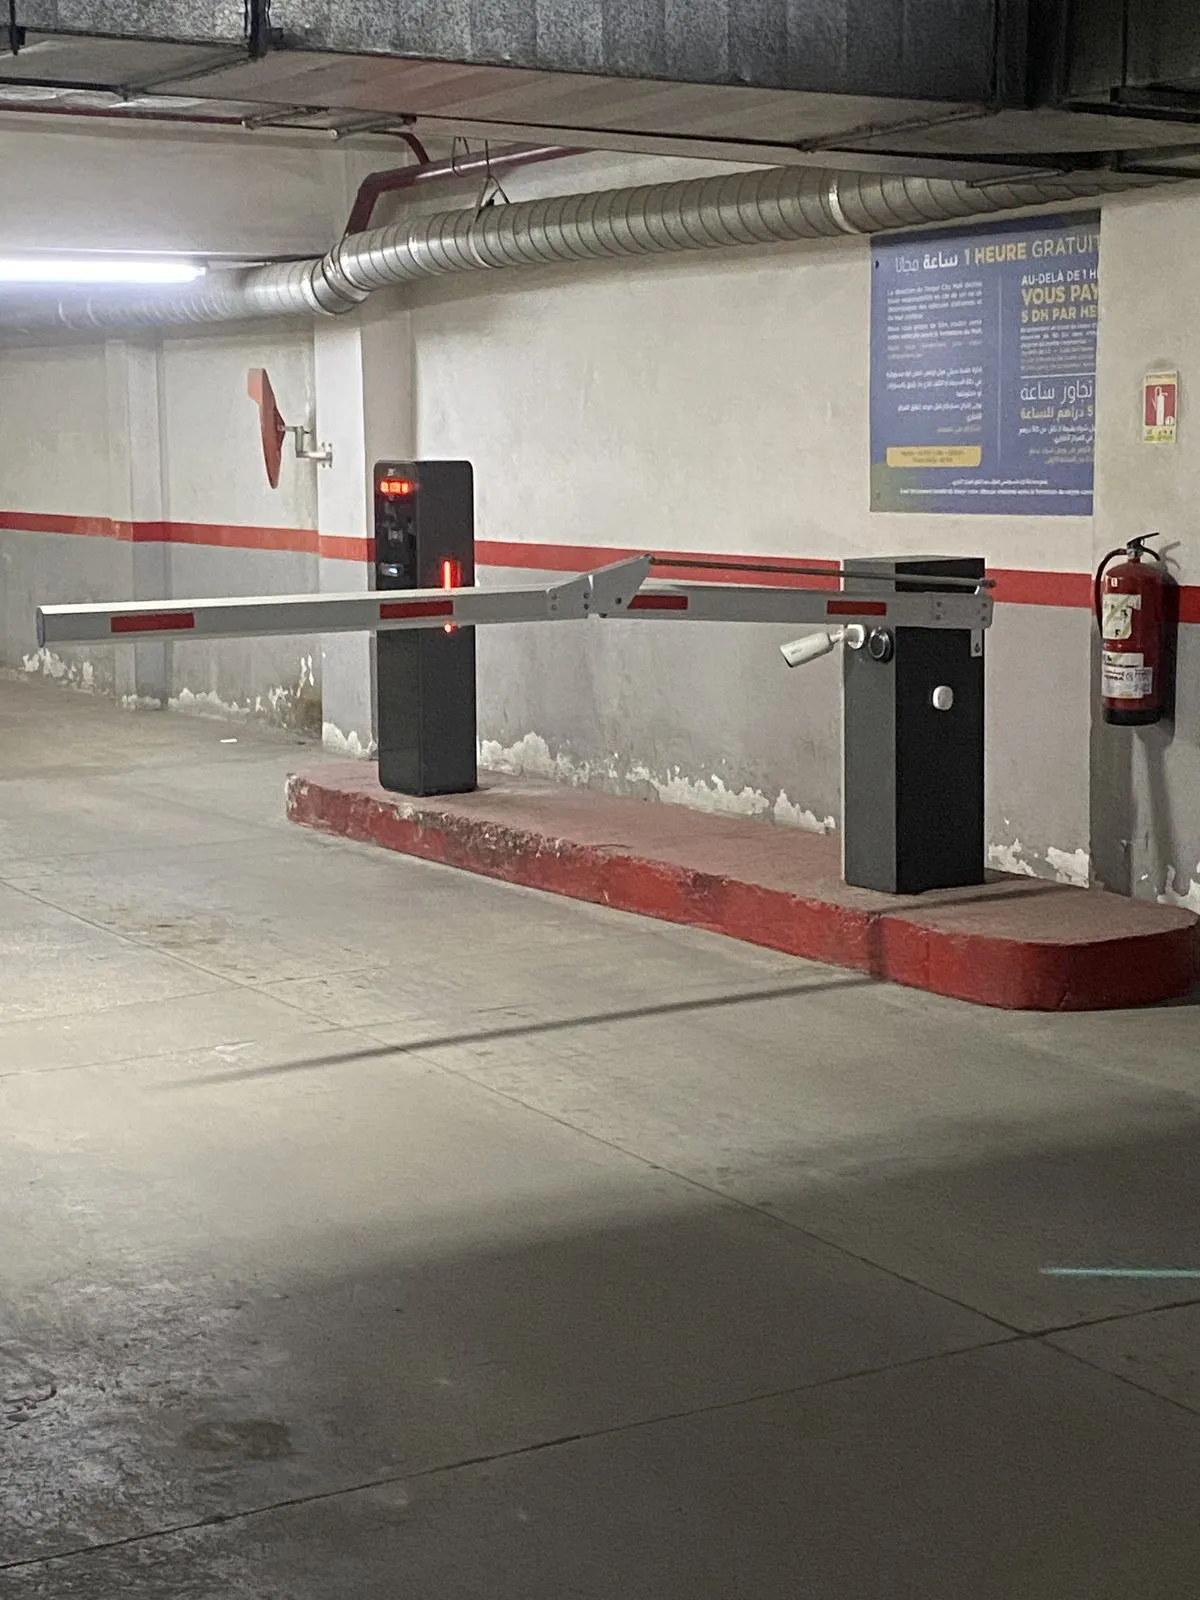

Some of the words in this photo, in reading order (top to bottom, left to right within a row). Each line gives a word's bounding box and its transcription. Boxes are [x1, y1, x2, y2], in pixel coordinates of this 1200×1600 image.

[923, 251, 958, 270] ساعة
[964, 247, 970, 265] 1
[974, 242, 1027, 266] HEURE
[1021, 268, 1065, 286] AU-DELÀ
[1066, 269, 1081, 282] DE
[1082, 268, 1087, 280] 1
[1021, 285, 1066, 306] VOUS
[1021, 310, 1029, 324] 5
[1031, 308, 1049, 323] DH
[1052, 306, 1077, 321] PAR
[1020, 380, 1056, 401] ساعة
